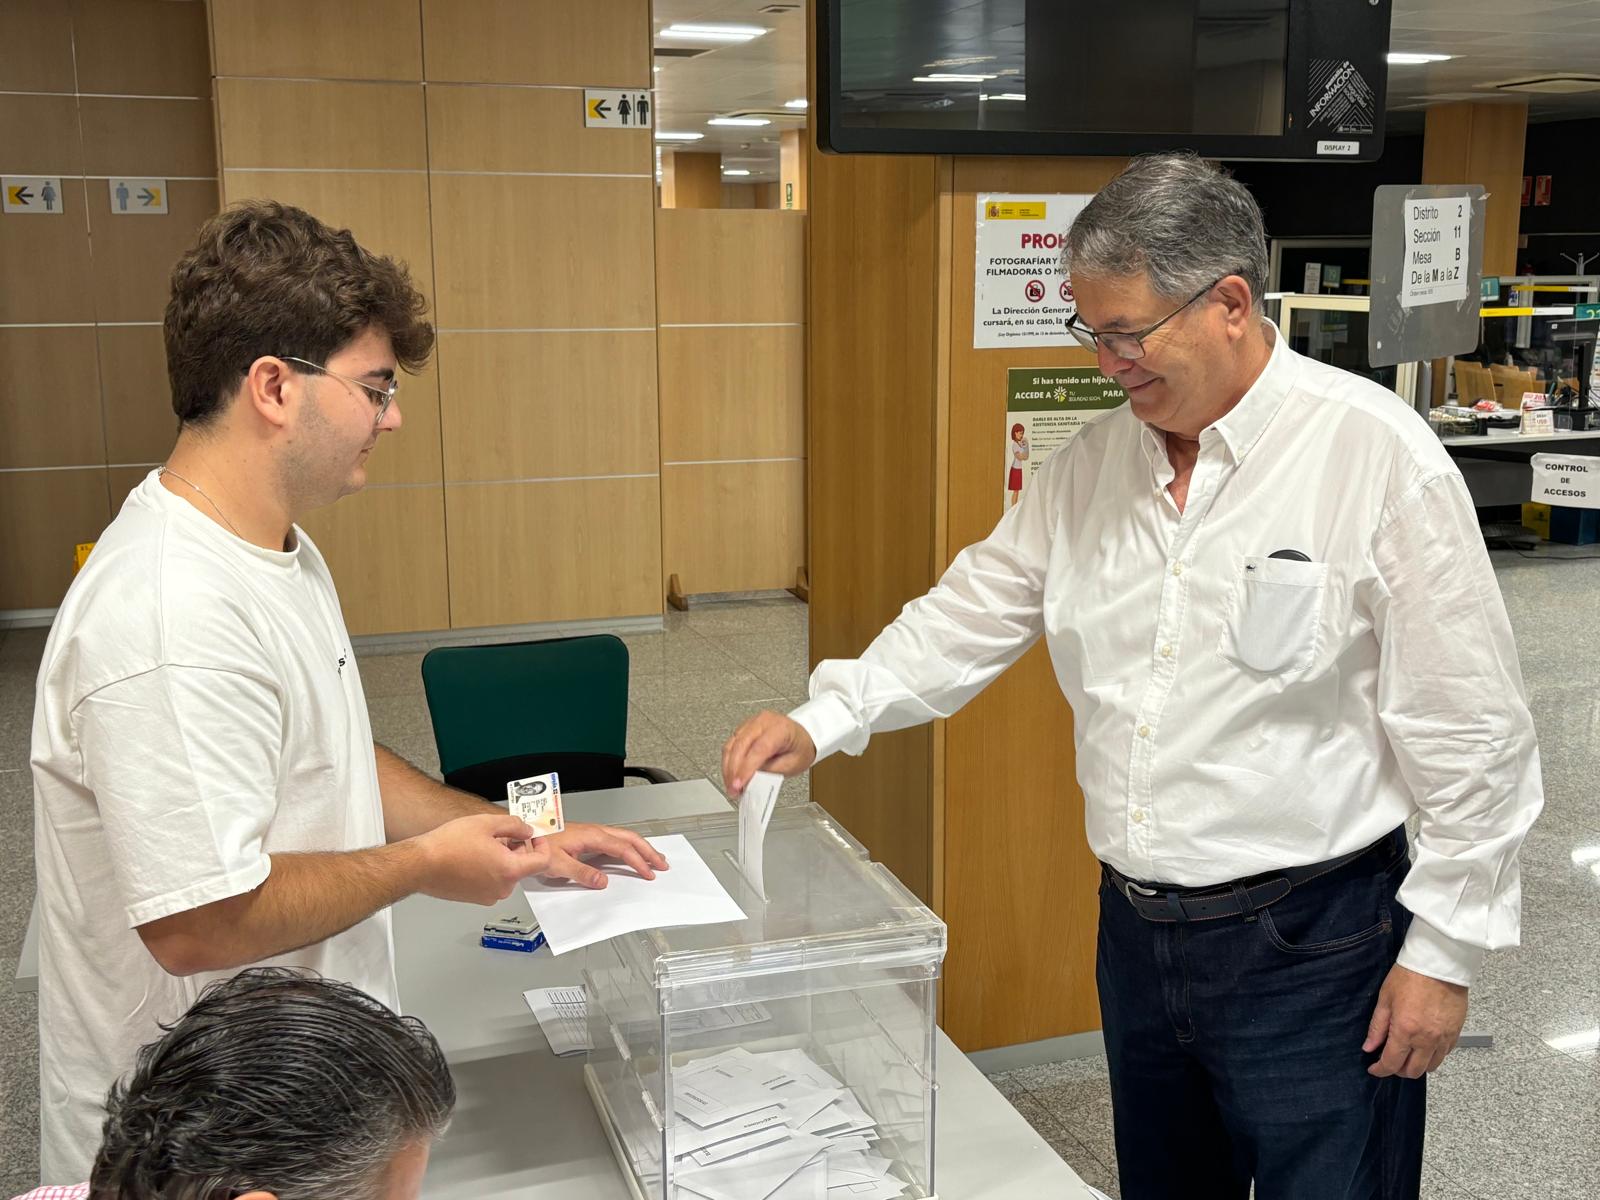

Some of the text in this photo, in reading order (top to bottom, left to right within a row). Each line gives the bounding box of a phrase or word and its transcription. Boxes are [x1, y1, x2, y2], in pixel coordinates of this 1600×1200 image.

[1414, 204, 1462, 220] Distrito 2
[1414, 225, 1461, 244] Sección 11
[1412, 248, 1460, 265] Mesa B
[986, 268, 1043, 276] FILMADORAS
[1411, 266, 1459, 285] De la M a la Z
[1004, 306, 1040, 314] Dirección
[983, 318, 1014, 327] cursará,
[1056, 317, 1062, 325] la
[1015, 391, 1044, 399] ACCEDE
[1545, 463, 1588, 472] CONTROL
[1544, 488, 1586, 497] ACCESOS
